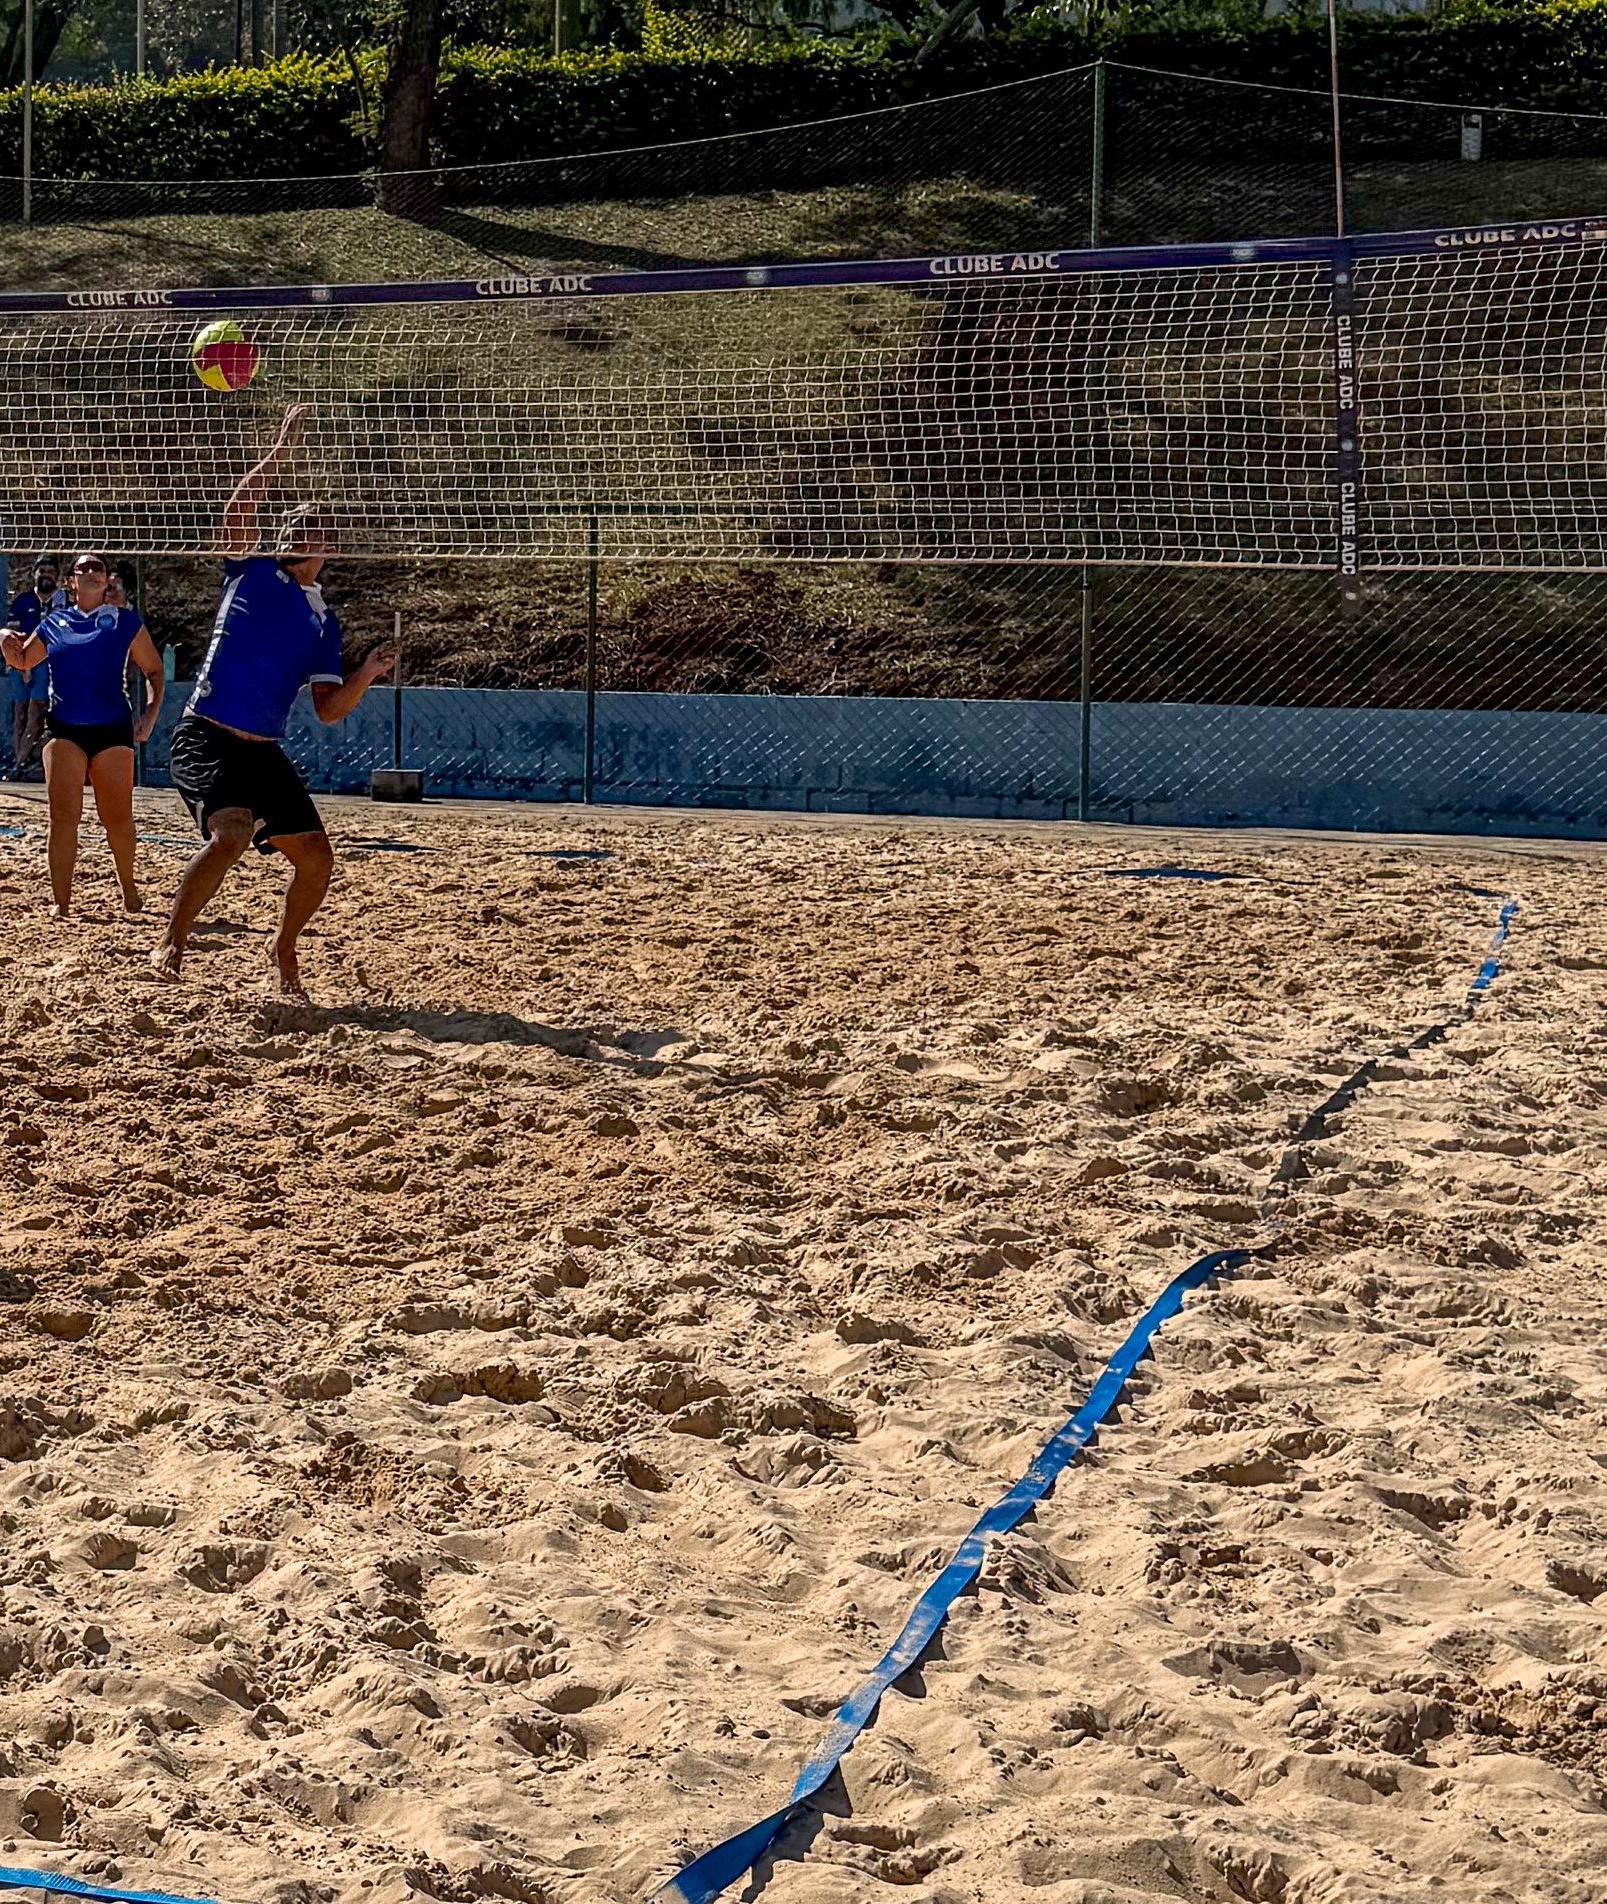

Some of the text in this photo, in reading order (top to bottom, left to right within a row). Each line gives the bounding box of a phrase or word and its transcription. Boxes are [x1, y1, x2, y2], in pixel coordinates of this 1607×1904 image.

[1434, 229, 1516, 247] CLUBE
[1523, 224, 1576, 240] ADC
[929, 253, 1060, 275] CLUBE ADC
[475, 275, 592, 295] CLUBE ADC
[67, 290, 173, 306] CLUBE ADC
[1337, 315, 1354, 410] CLUBE ADC
[1341, 482, 1356, 575] CLUBE ADC
